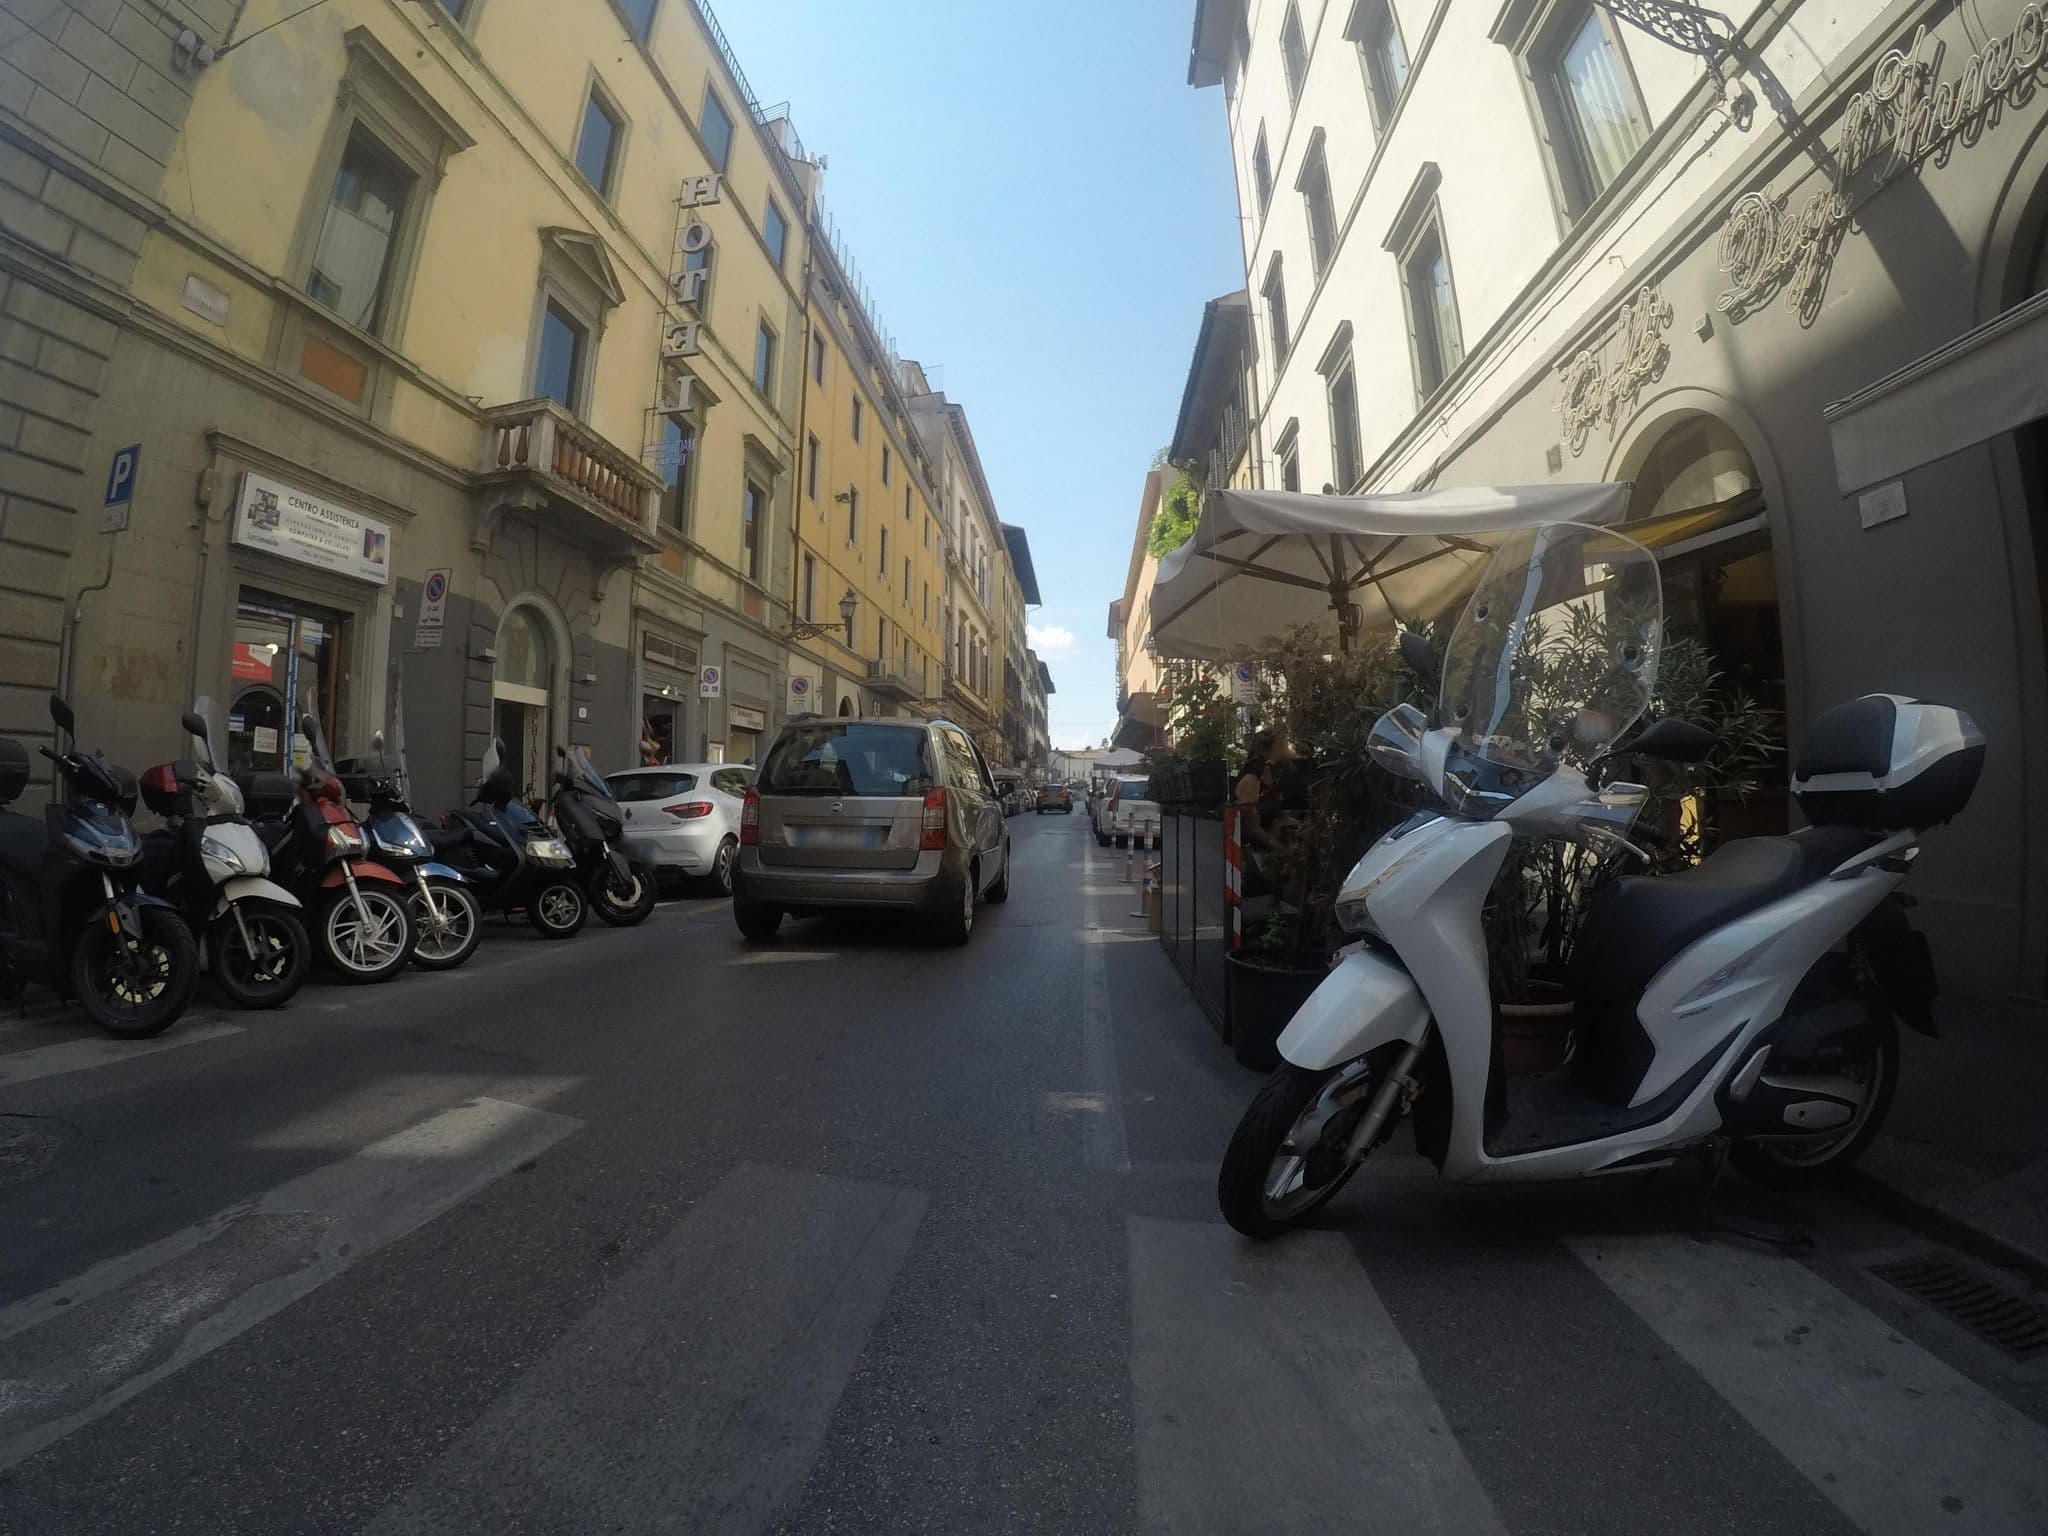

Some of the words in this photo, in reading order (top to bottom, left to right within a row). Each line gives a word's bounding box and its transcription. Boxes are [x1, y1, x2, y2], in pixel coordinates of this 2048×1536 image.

[111, 453, 132, 499] P
[288, 496, 319, 515] CENTRO
[319, 508, 360, 530] ASSISTENZA
[289, 527, 318, 542] COMPUTER
